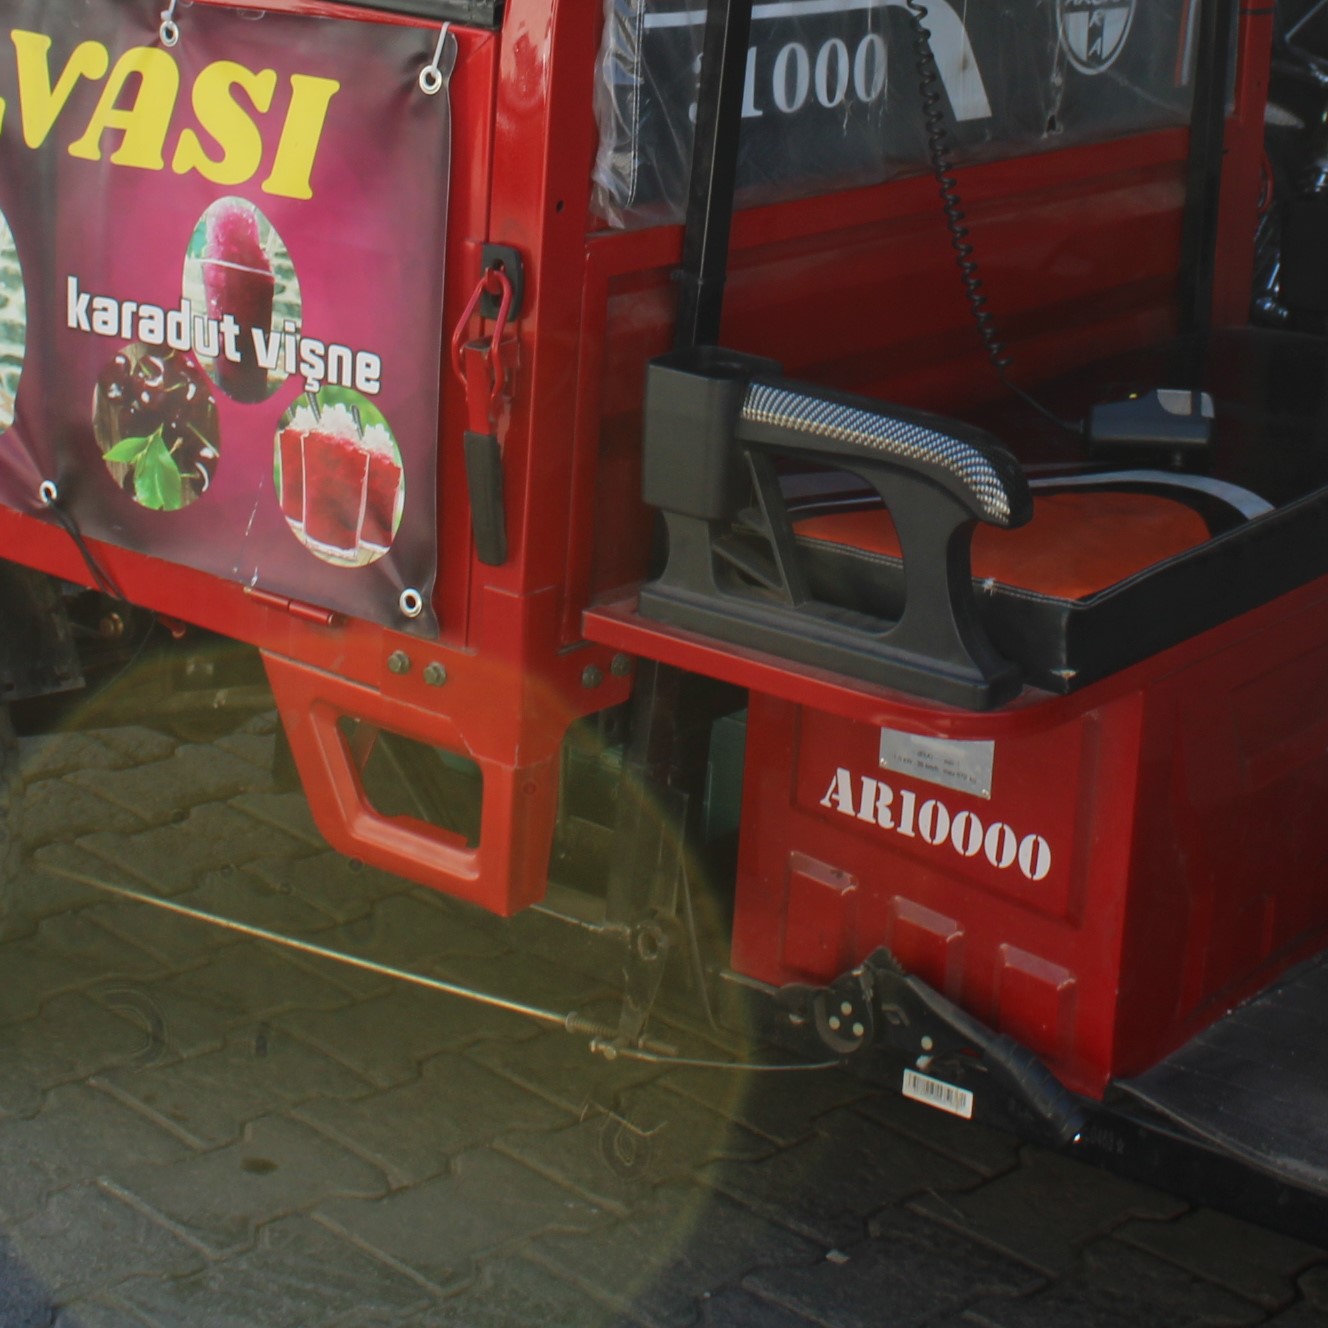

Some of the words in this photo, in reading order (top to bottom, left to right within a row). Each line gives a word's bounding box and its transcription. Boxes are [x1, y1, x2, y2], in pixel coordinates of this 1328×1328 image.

[67, 276, 240, 363] karadut
[251, 321, 381, 395] vişne
[819, 767, 1052, 882] AR10000
